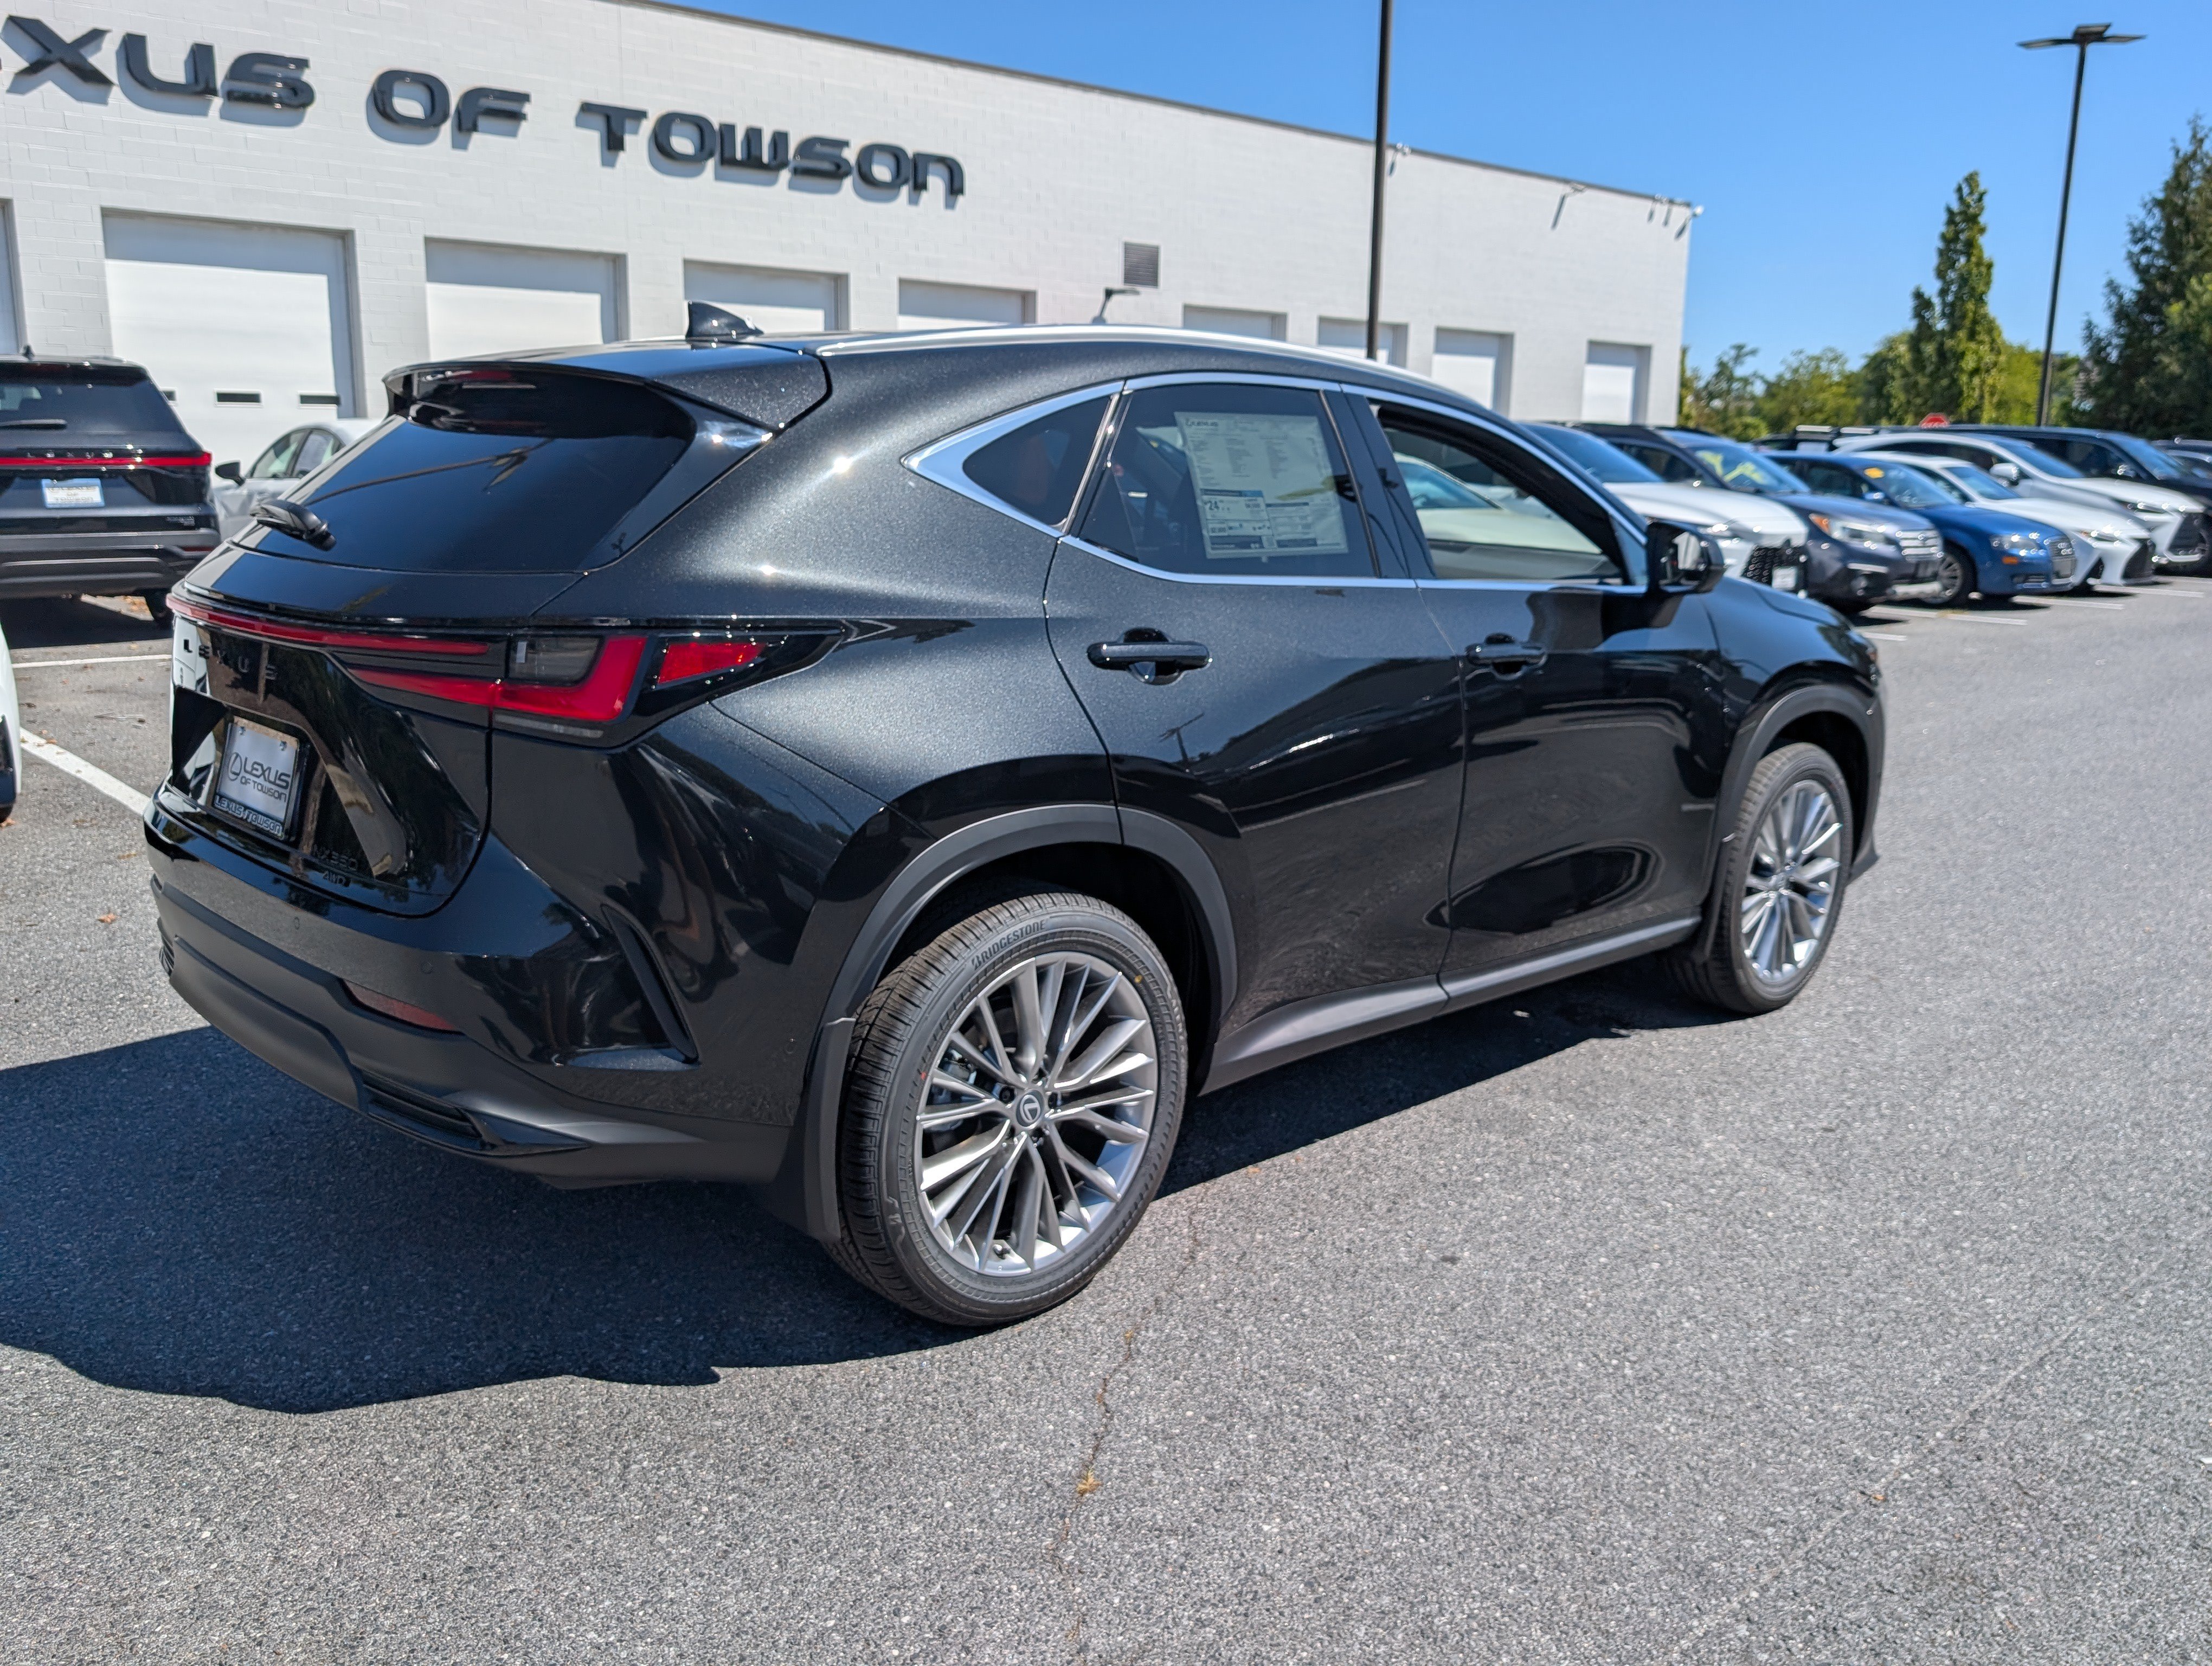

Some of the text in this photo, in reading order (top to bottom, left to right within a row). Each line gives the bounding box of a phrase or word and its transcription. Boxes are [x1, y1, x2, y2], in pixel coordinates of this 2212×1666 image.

[0, 15, 964, 196] XUS OF TOWSON
[183, 638, 278, 680] LEXUS
[240, 776, 287, 803] OF TOWSON
[243, 756, 291, 790] LEXUS
[971, 918, 1046, 971] BRIDGESTONE
